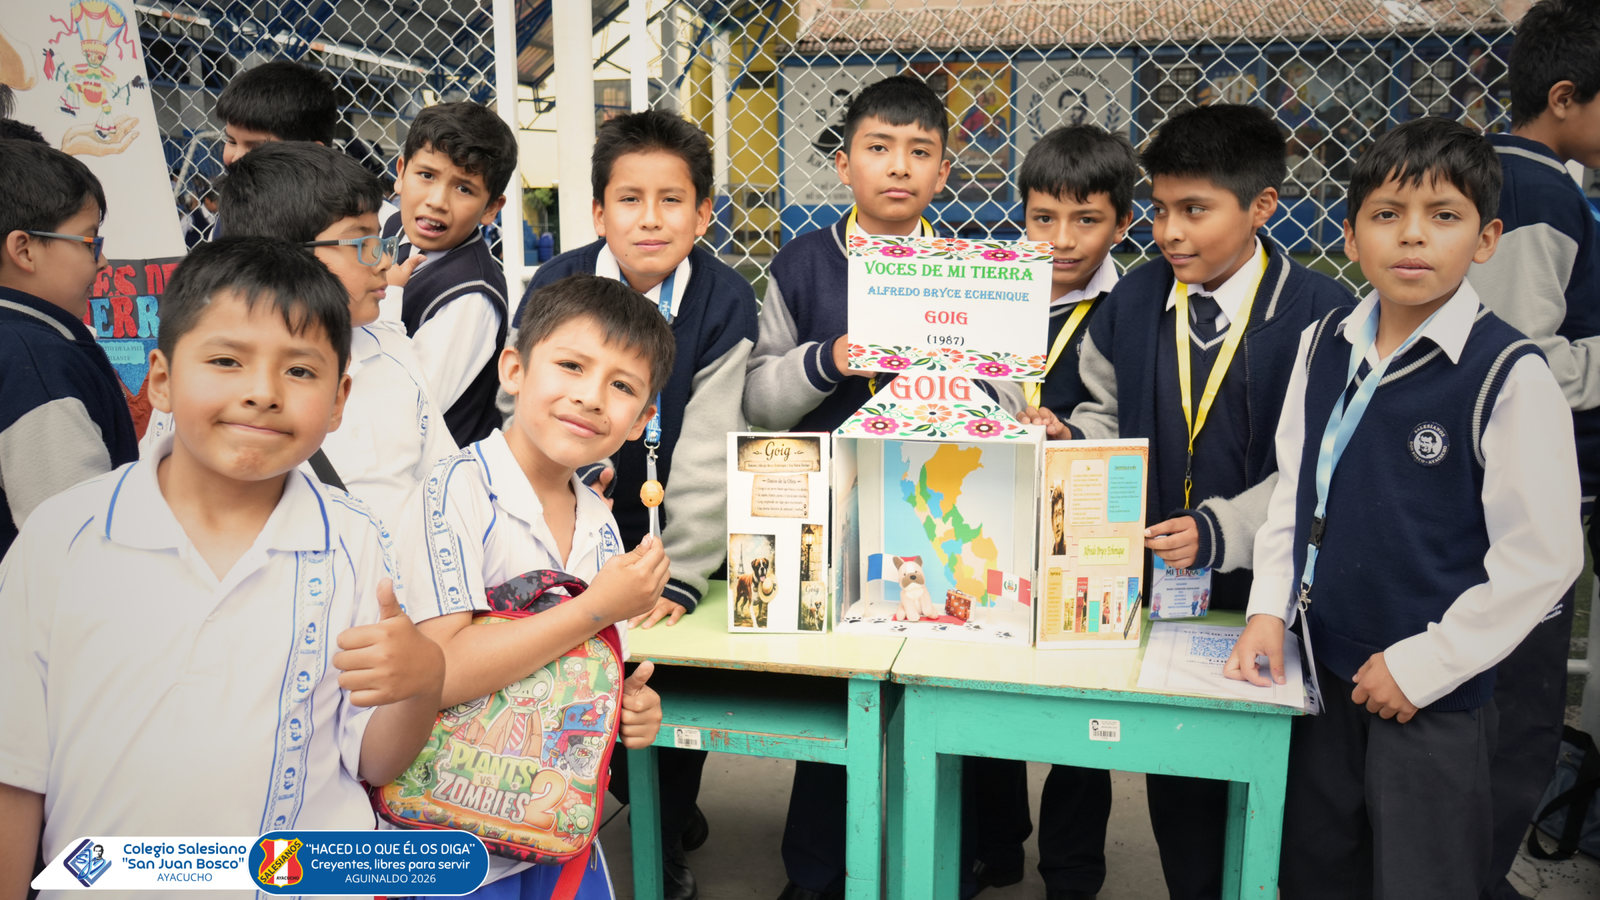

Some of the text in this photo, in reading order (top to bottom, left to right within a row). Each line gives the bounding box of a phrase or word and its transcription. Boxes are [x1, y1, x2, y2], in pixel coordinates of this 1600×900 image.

[864, 260, 1034, 281] VOCES DE MI TIERRA
[89, 264, 138, 296] ES
[867, 286, 1029, 302] ALFREDO BRYCE ECHENIQUE
[924, 310, 968, 325] GOIG
[926, 334, 965, 346] (1987)
[889, 375, 972, 401] GOIG
[1414, 424, 1446, 437] SALESIANOS
[765, 441, 791, 461] Goig
[805, 584, 820, 595] Goig
[449, 739, 539, 787] PLANTS
[479, 775, 494, 787] VS.
[432, 768, 568, 831] ZOMBIES 2
